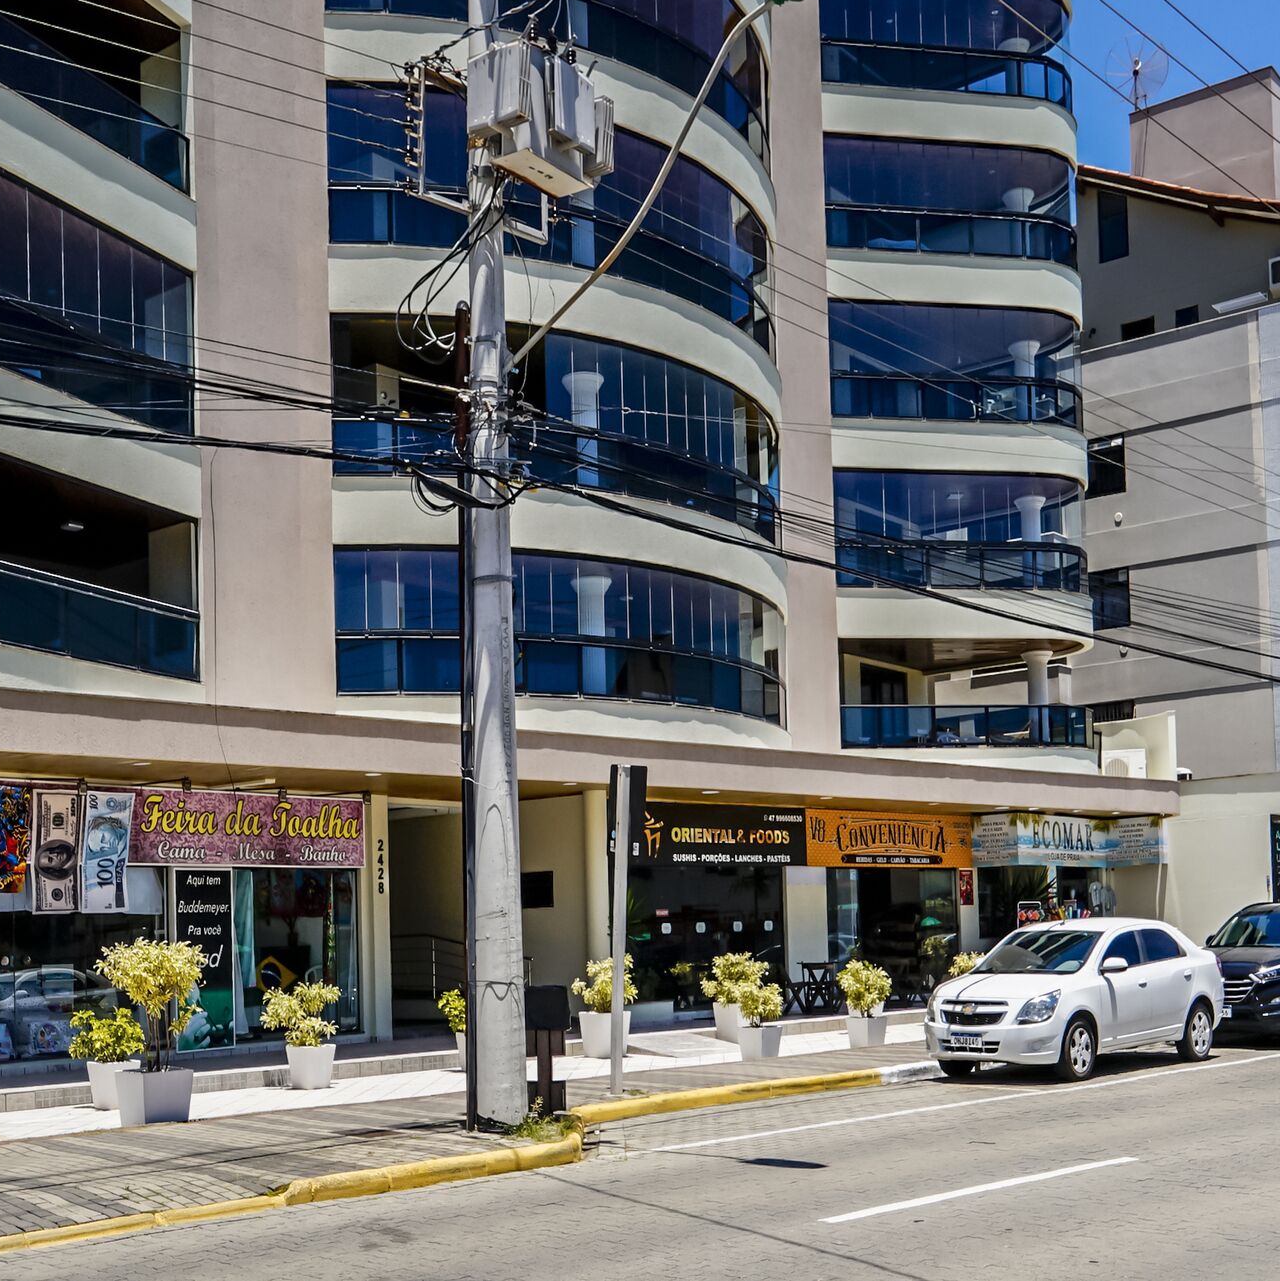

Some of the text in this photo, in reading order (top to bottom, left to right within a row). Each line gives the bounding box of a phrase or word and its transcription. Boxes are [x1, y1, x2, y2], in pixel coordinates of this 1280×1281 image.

[89, 794, 99, 810] 100
[140, 793, 360, 840] Feira da Toalha
[671, 827, 736, 844] ORIENTAL
[736, 829, 746, 844] &
[809, 816, 826, 843] V8
[1032, 820, 1095, 852] ECOMAR
[157, 839, 206, 860] Cama
[233, 842, 276, 861] Mesa
[300, 845, 348, 863] Banho
[672, 852, 791, 864] SUSHIS PORÇÕES LANCHES PASTÉIS
[1048, 853, 1081, 861] LOJA DE PRAIA
[96, 858, 115, 889] 100
[377, 838, 385, 895] 2428
[186, 874, 221, 888] Aqui tem
[177, 900, 230, 916] Buddemeyer.
[187, 924, 222, 936] Pra você
